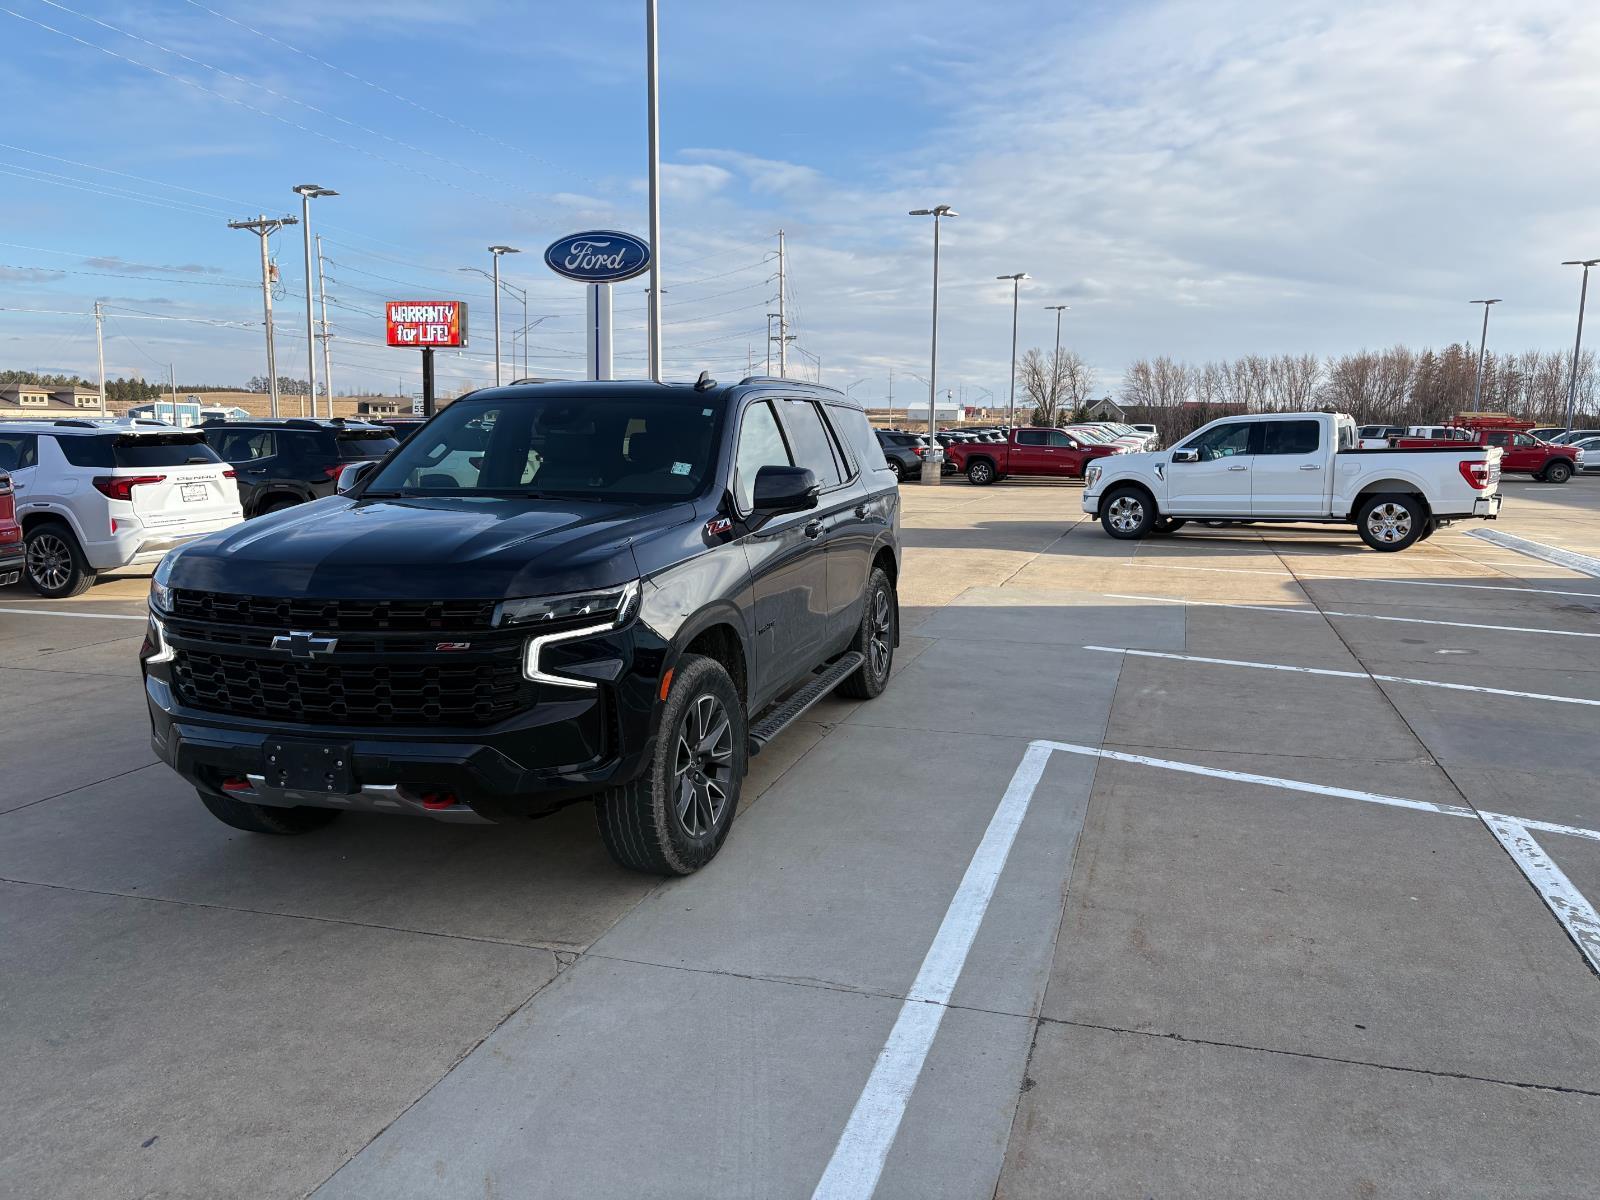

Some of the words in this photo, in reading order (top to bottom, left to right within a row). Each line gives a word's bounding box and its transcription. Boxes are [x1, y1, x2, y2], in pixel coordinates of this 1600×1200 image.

[565, 240, 626, 270] Ford
[391, 306, 454, 323] WARRANTY
[397, 325, 417, 342] for
[419, 325, 448, 342] LIFE!
